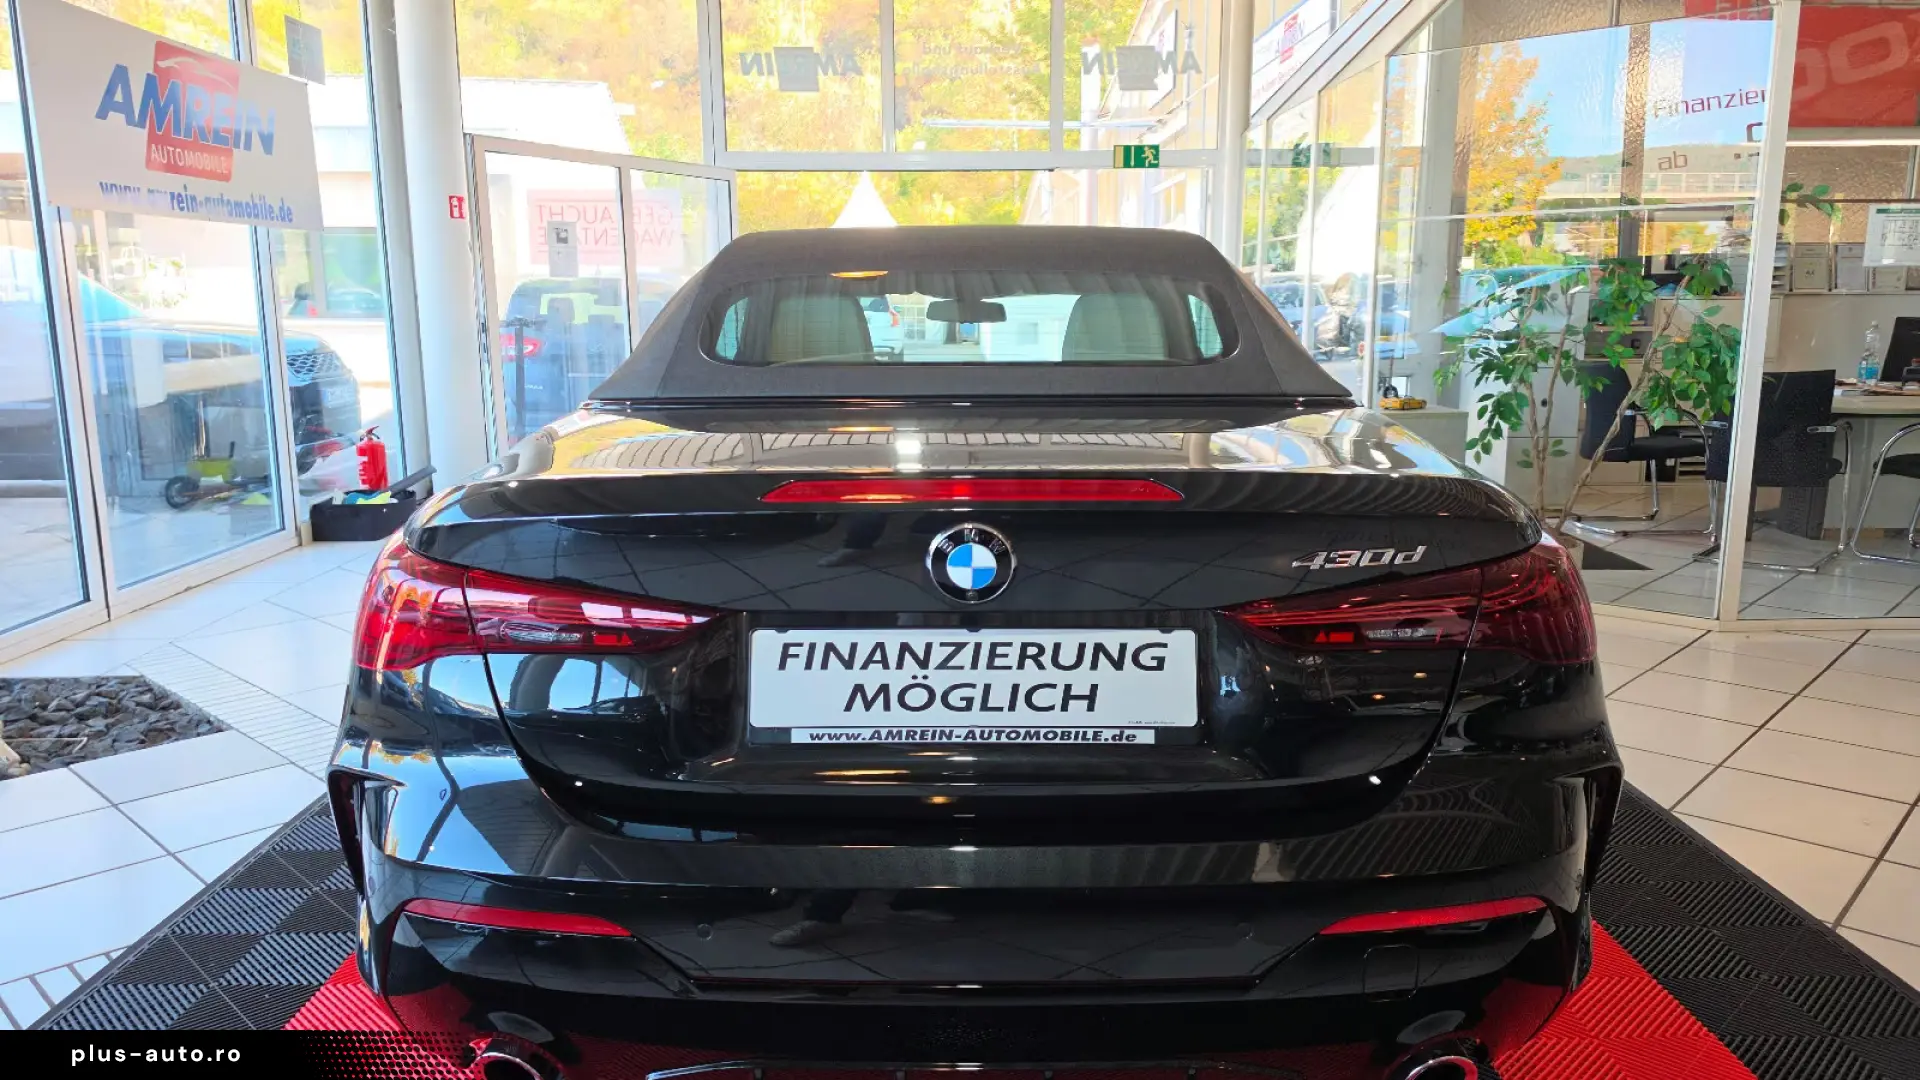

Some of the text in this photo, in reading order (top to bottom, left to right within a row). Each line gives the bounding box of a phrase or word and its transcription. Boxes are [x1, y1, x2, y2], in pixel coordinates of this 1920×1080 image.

[95, 63, 277, 156] AMREIN
[150, 143, 230, 174] AUTOMOBILE
[1657, 150, 1689, 171] ab
[938, 528, 1006, 555] BMW
[1291, 545, 1428, 570] 430d
[777, 641, 1170, 672] FINANZIERUNG
[843, 674, 1099, 713] MÖGLICH
[809, 728, 1137, 744] www.AMREIN-AUTOMOBILE.de
